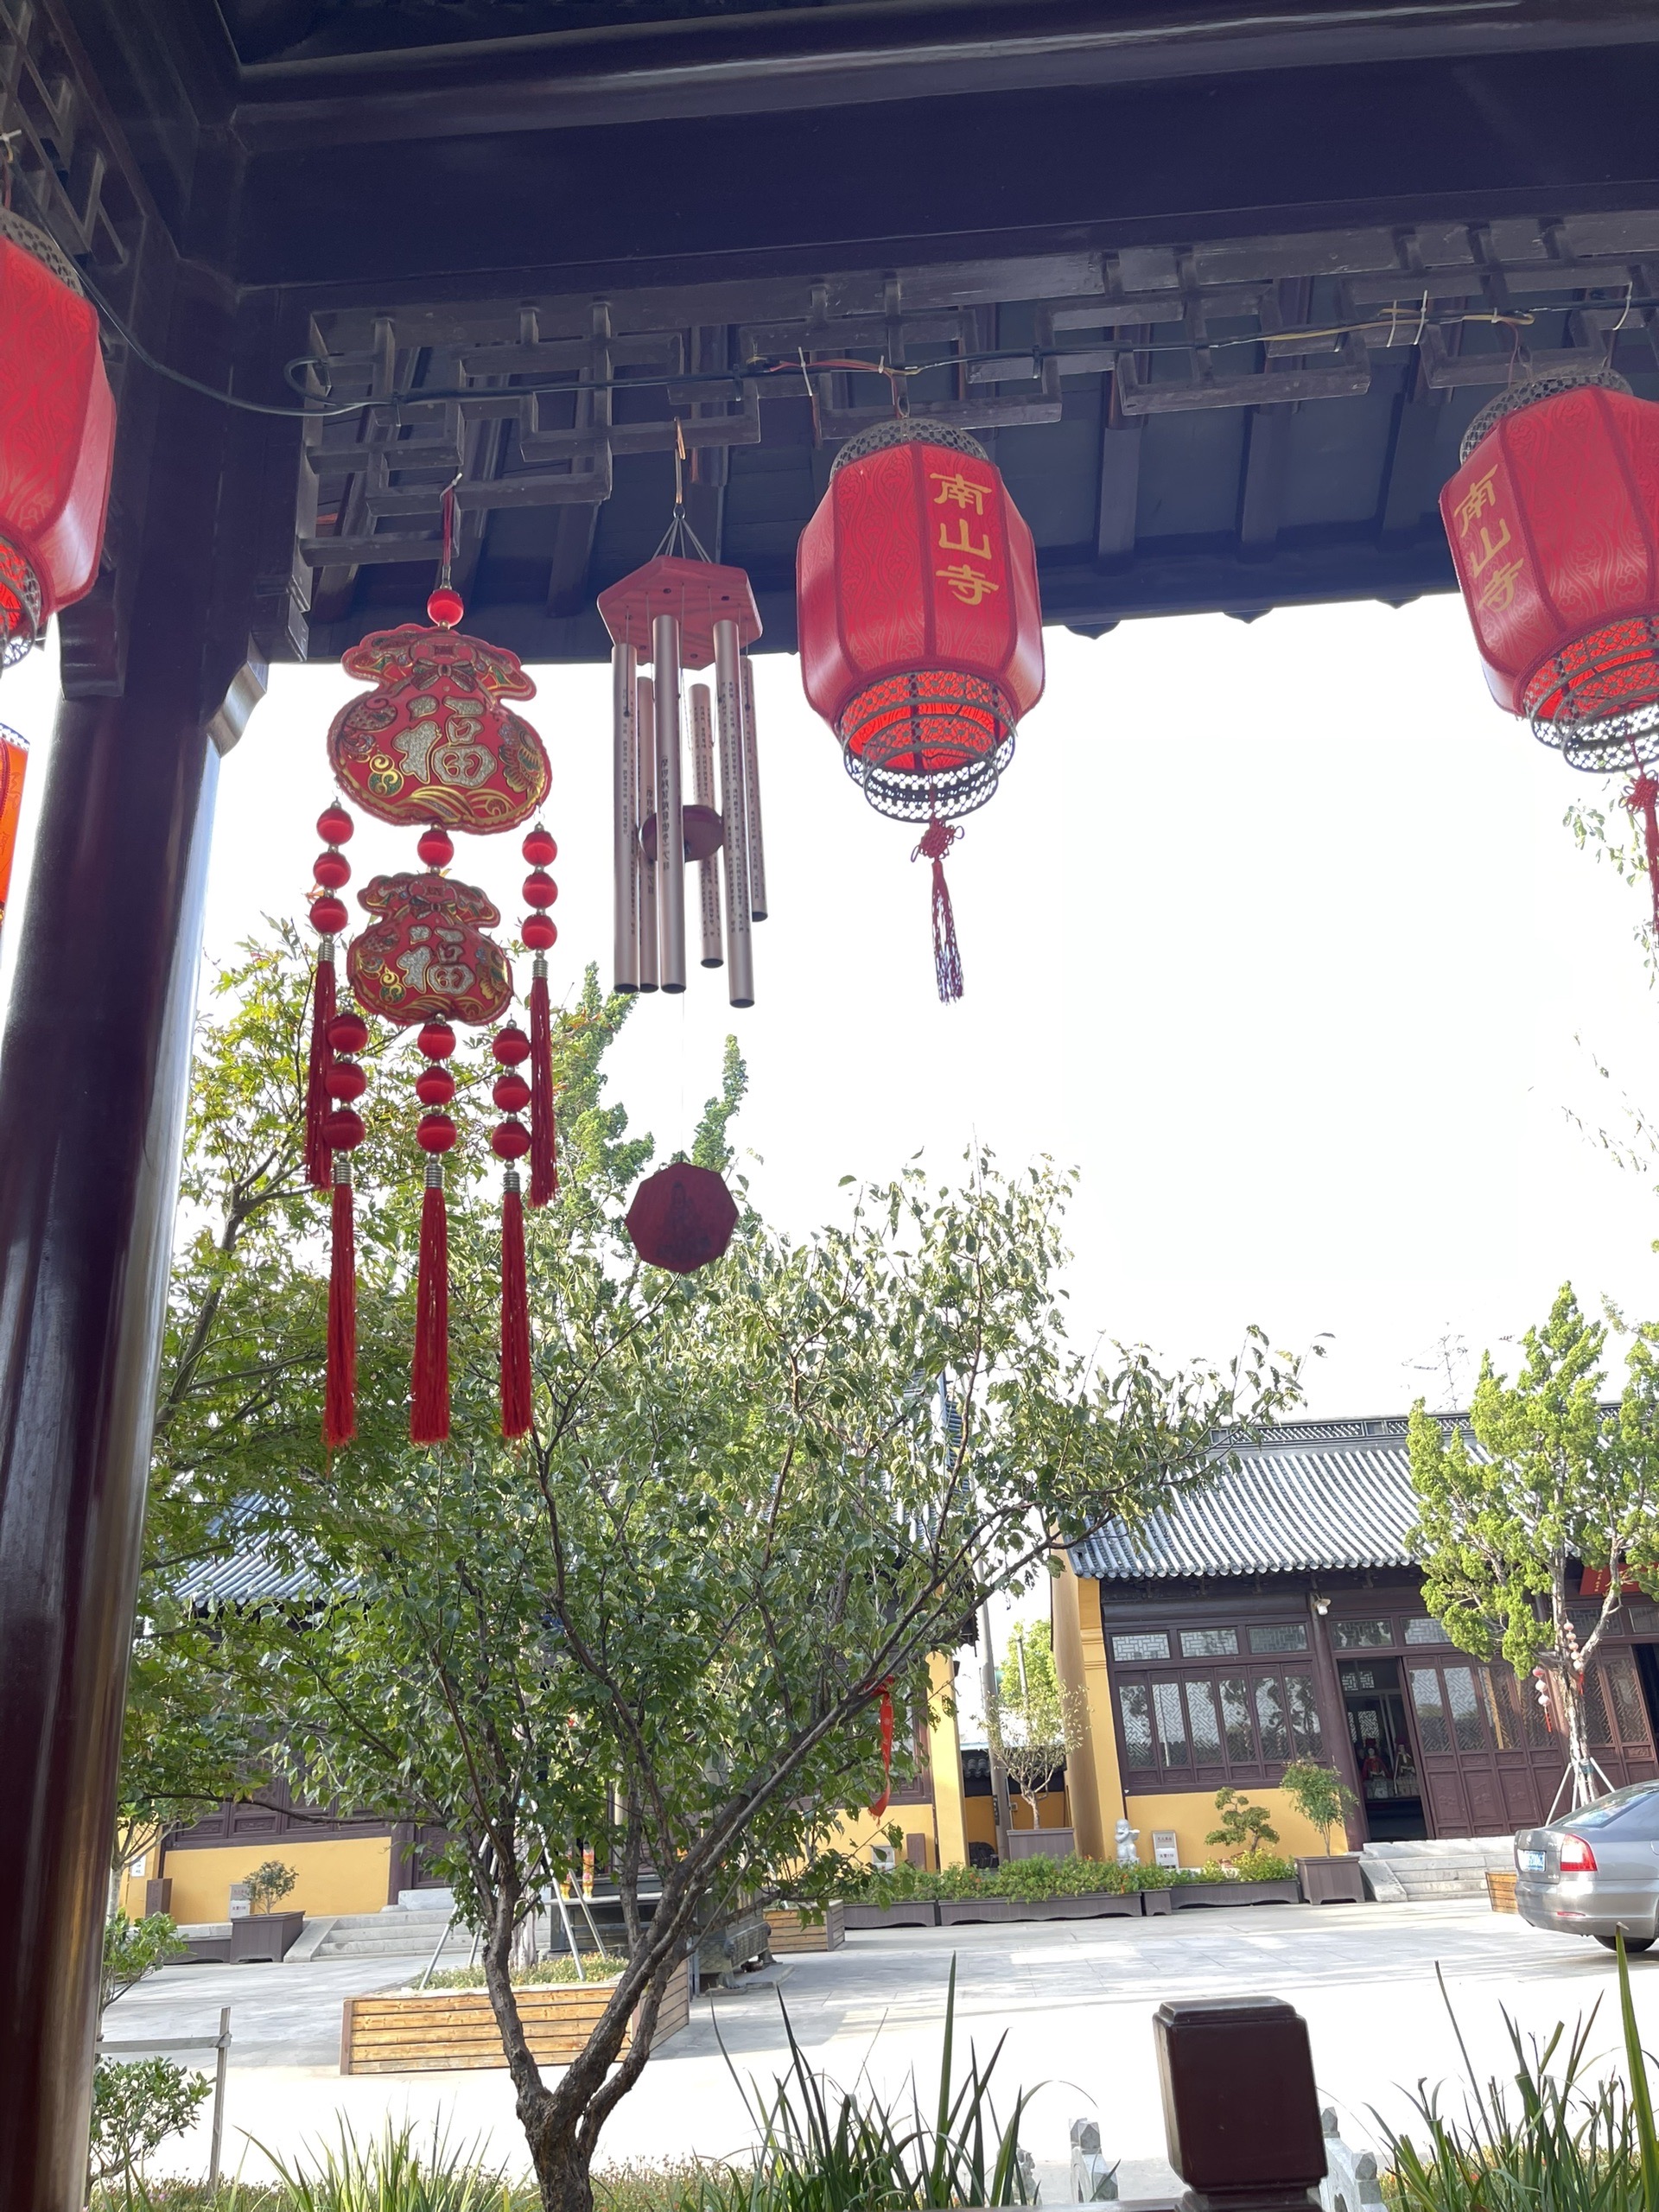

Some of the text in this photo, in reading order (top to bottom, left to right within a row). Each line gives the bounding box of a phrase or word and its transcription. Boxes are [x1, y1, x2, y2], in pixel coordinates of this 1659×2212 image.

[930, 474, 999, 606] 南山寺
[1454, 464, 1524, 612] 南山寺
[391, 695, 497, 790] 福
[397, 924, 476, 996] 福
